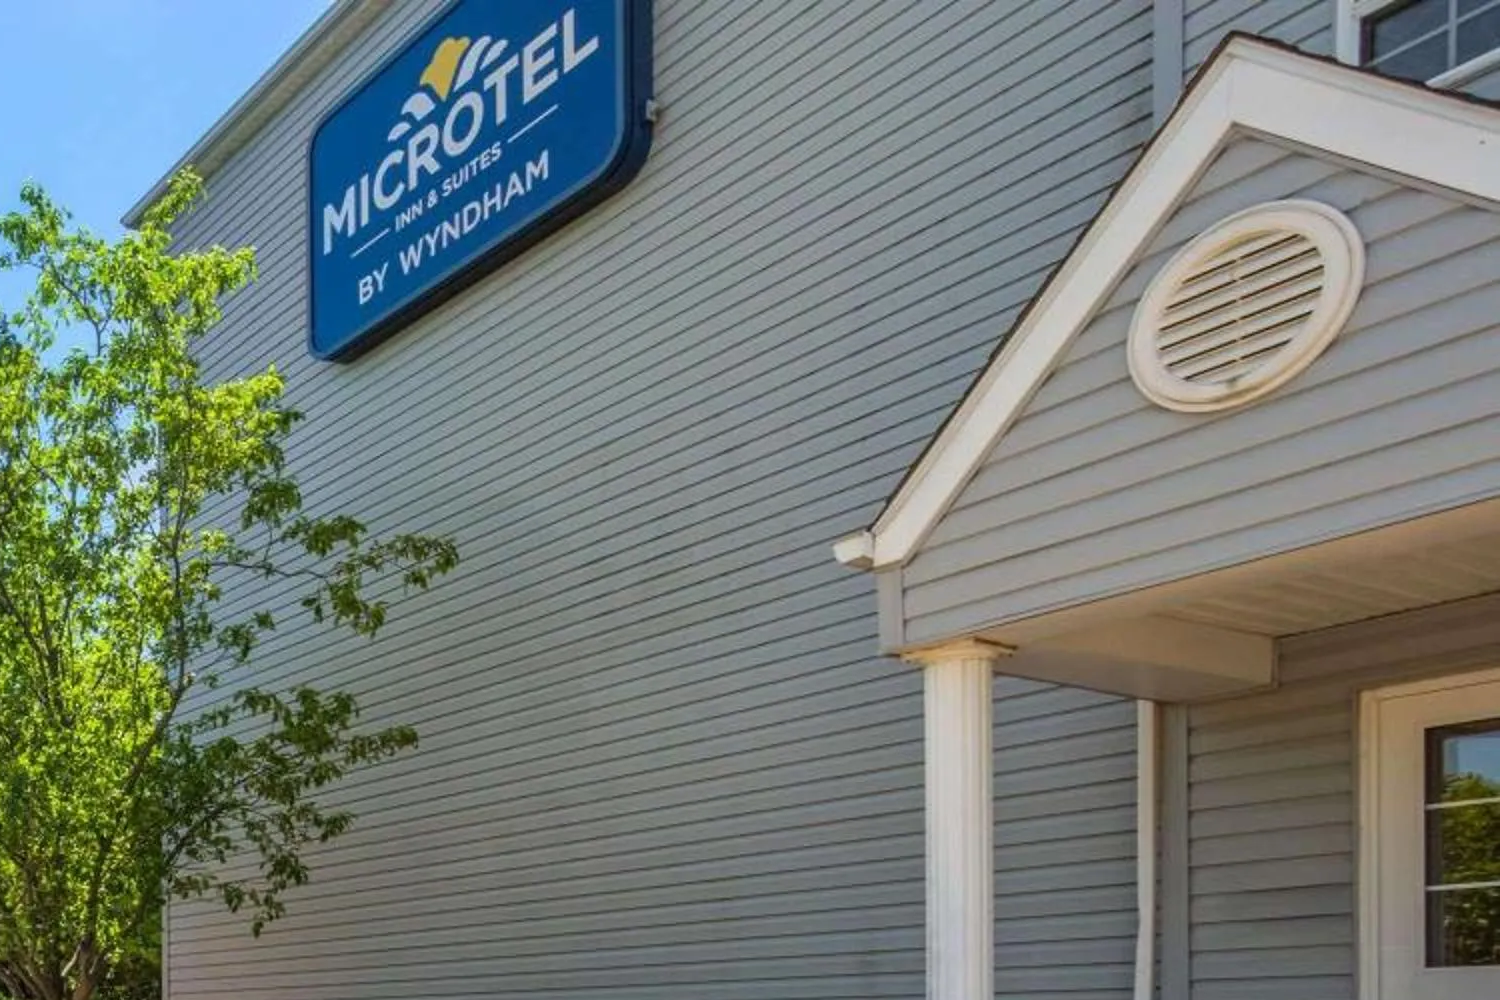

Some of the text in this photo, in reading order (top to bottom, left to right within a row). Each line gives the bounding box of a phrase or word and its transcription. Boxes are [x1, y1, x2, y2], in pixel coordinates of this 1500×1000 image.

[323, 8, 599, 256] MICROTEL
[395, 141, 502, 232] INN & SUITES
[358, 149, 549, 305] BY WYNDHAM
